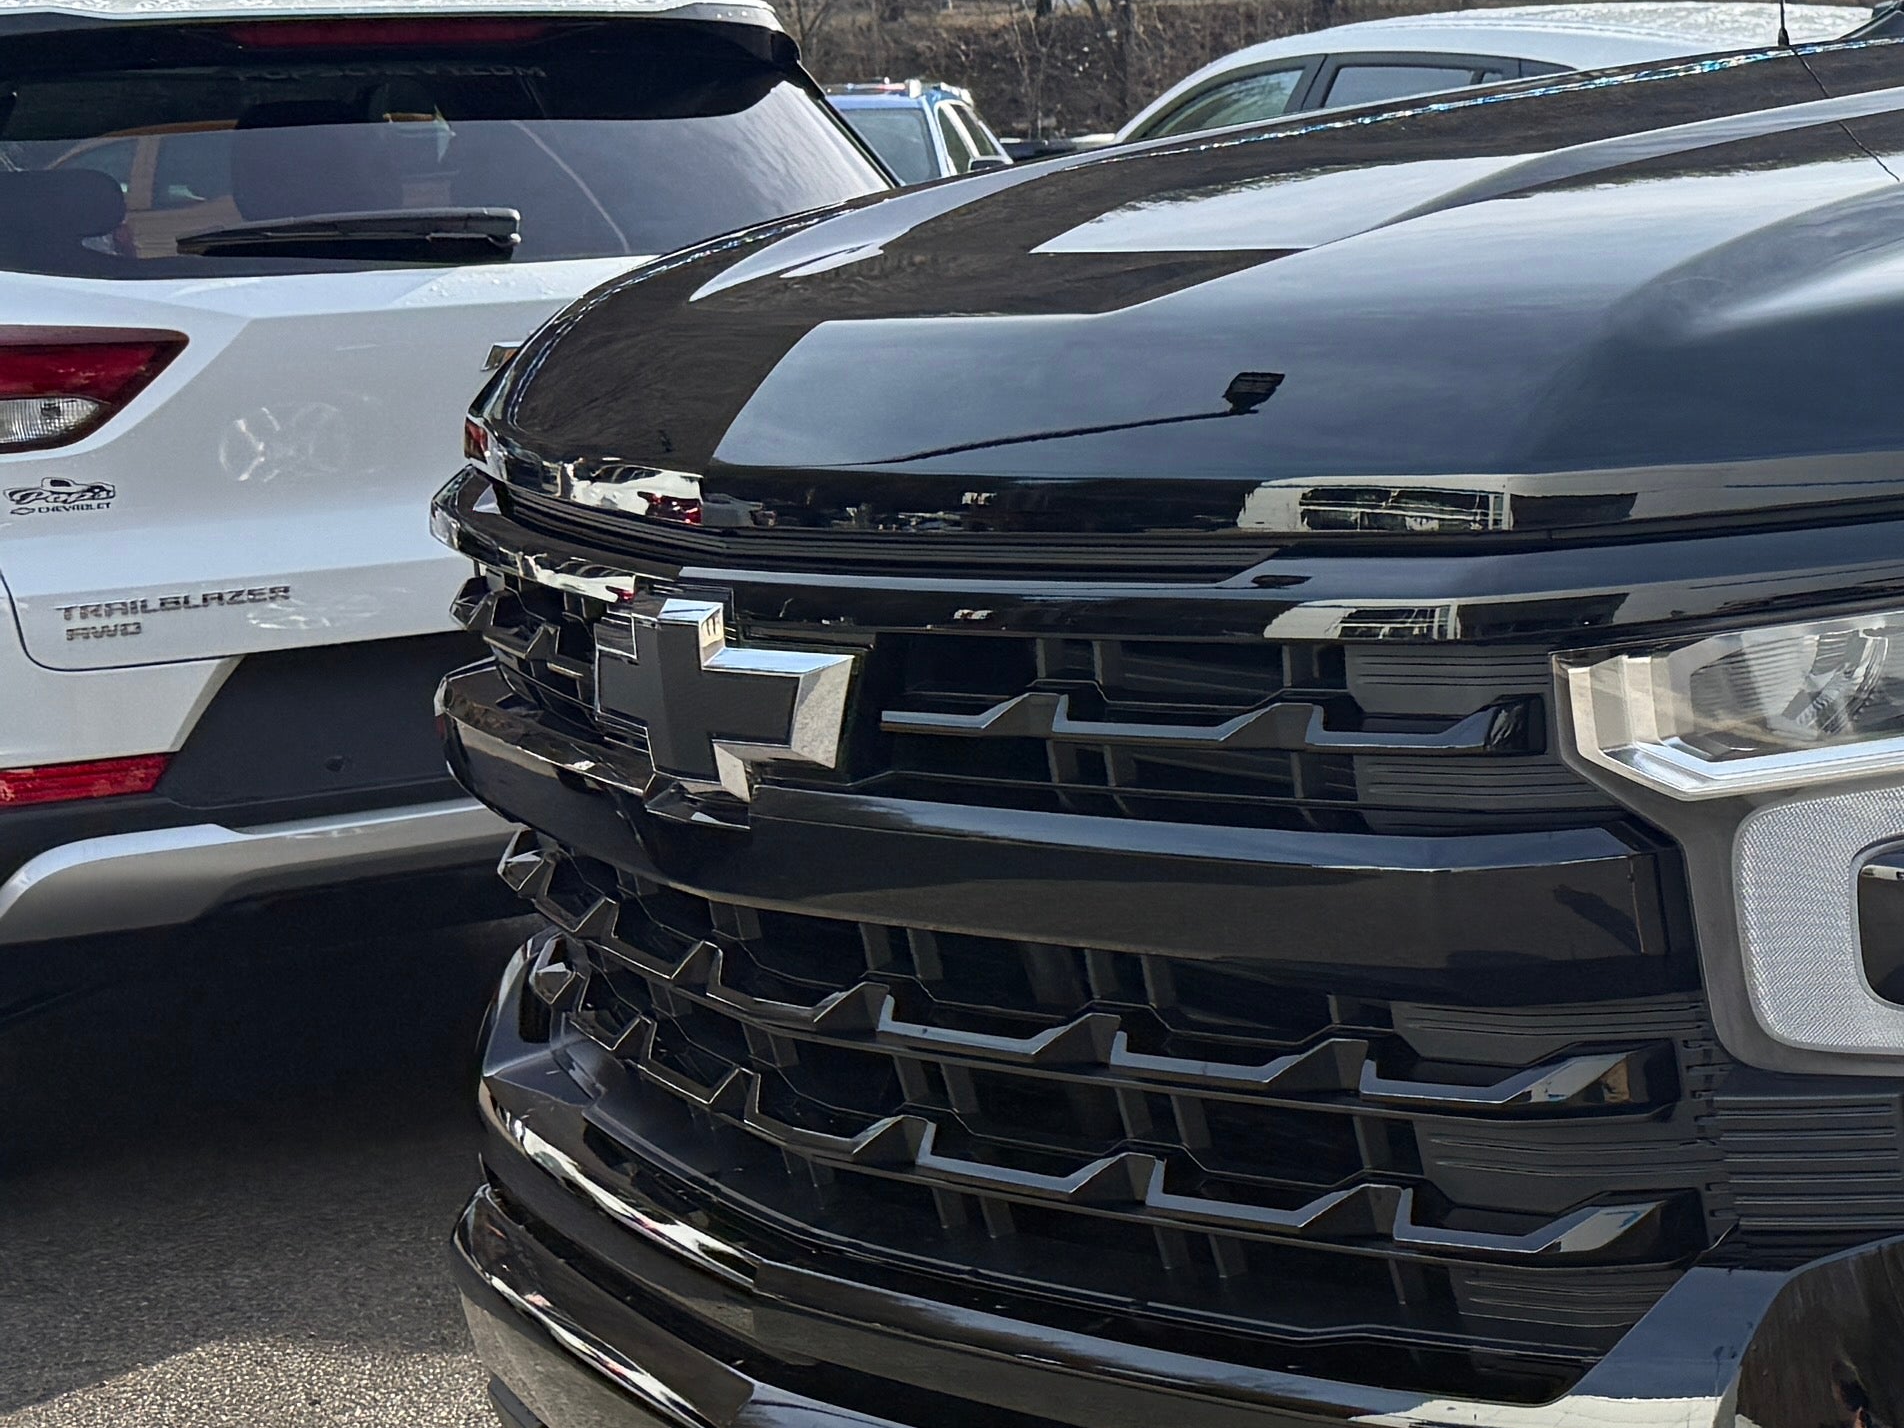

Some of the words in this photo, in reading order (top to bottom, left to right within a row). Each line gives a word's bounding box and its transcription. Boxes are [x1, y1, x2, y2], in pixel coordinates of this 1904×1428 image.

[38, 502, 111, 514] CHEVROLET
[56, 585, 291, 622] TRAILBLAZER
[66, 622, 142, 642] AWD
